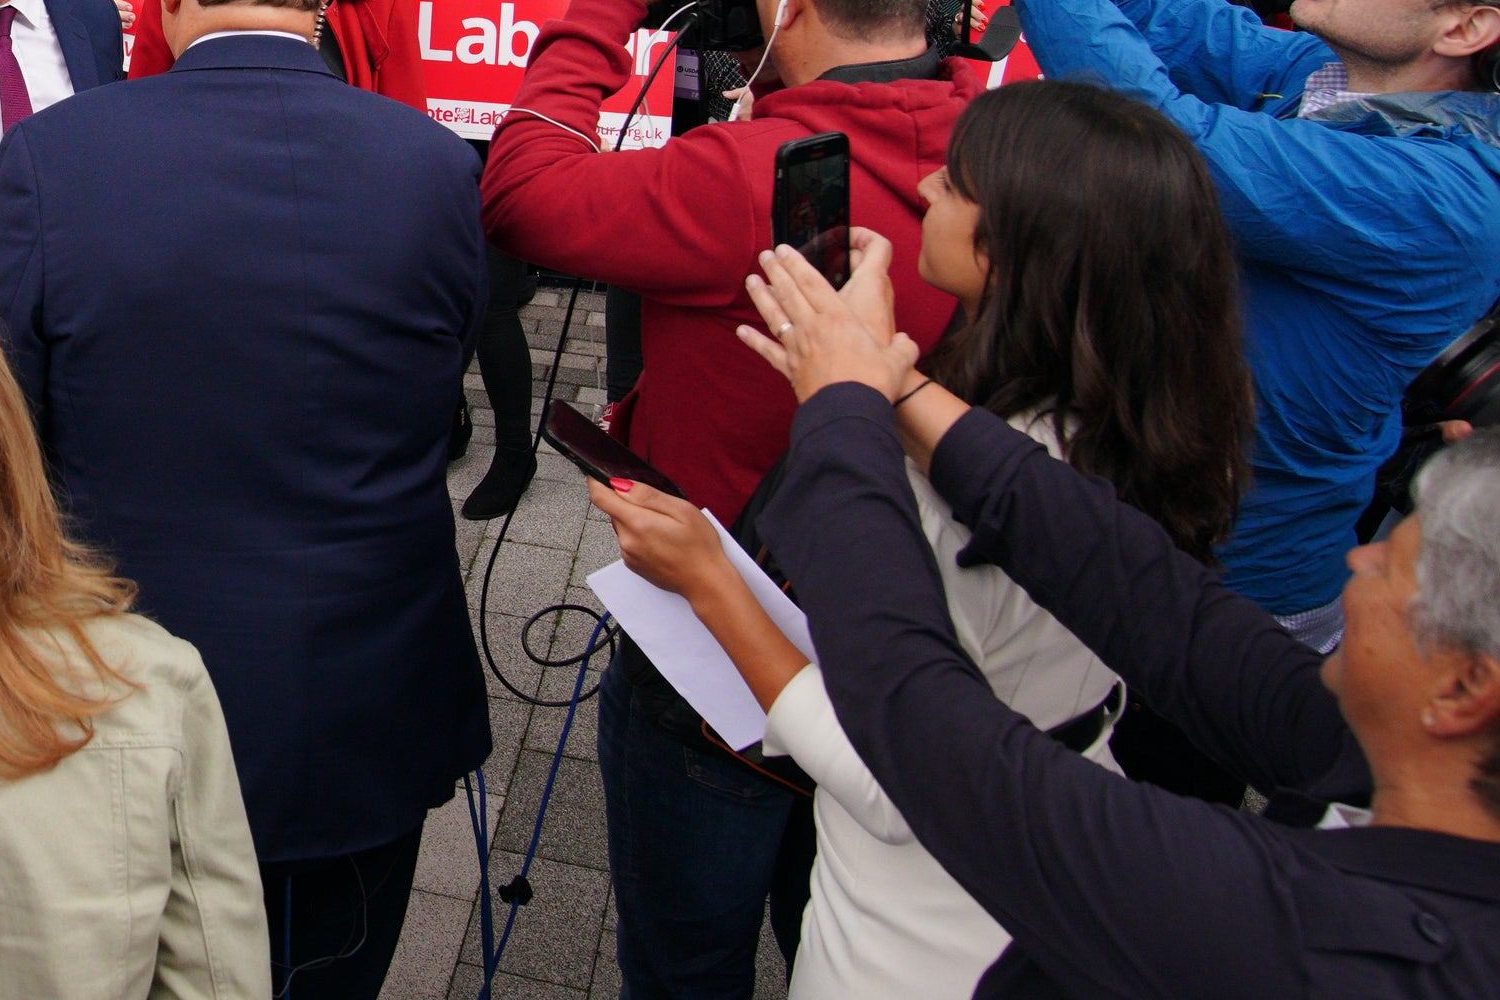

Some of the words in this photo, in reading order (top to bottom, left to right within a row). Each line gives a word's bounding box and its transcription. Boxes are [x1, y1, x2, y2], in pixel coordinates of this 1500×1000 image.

[418, 1, 668, 76] Labr
[427, 106, 454, 122] ote
[471, 108, 504, 126] Lab
